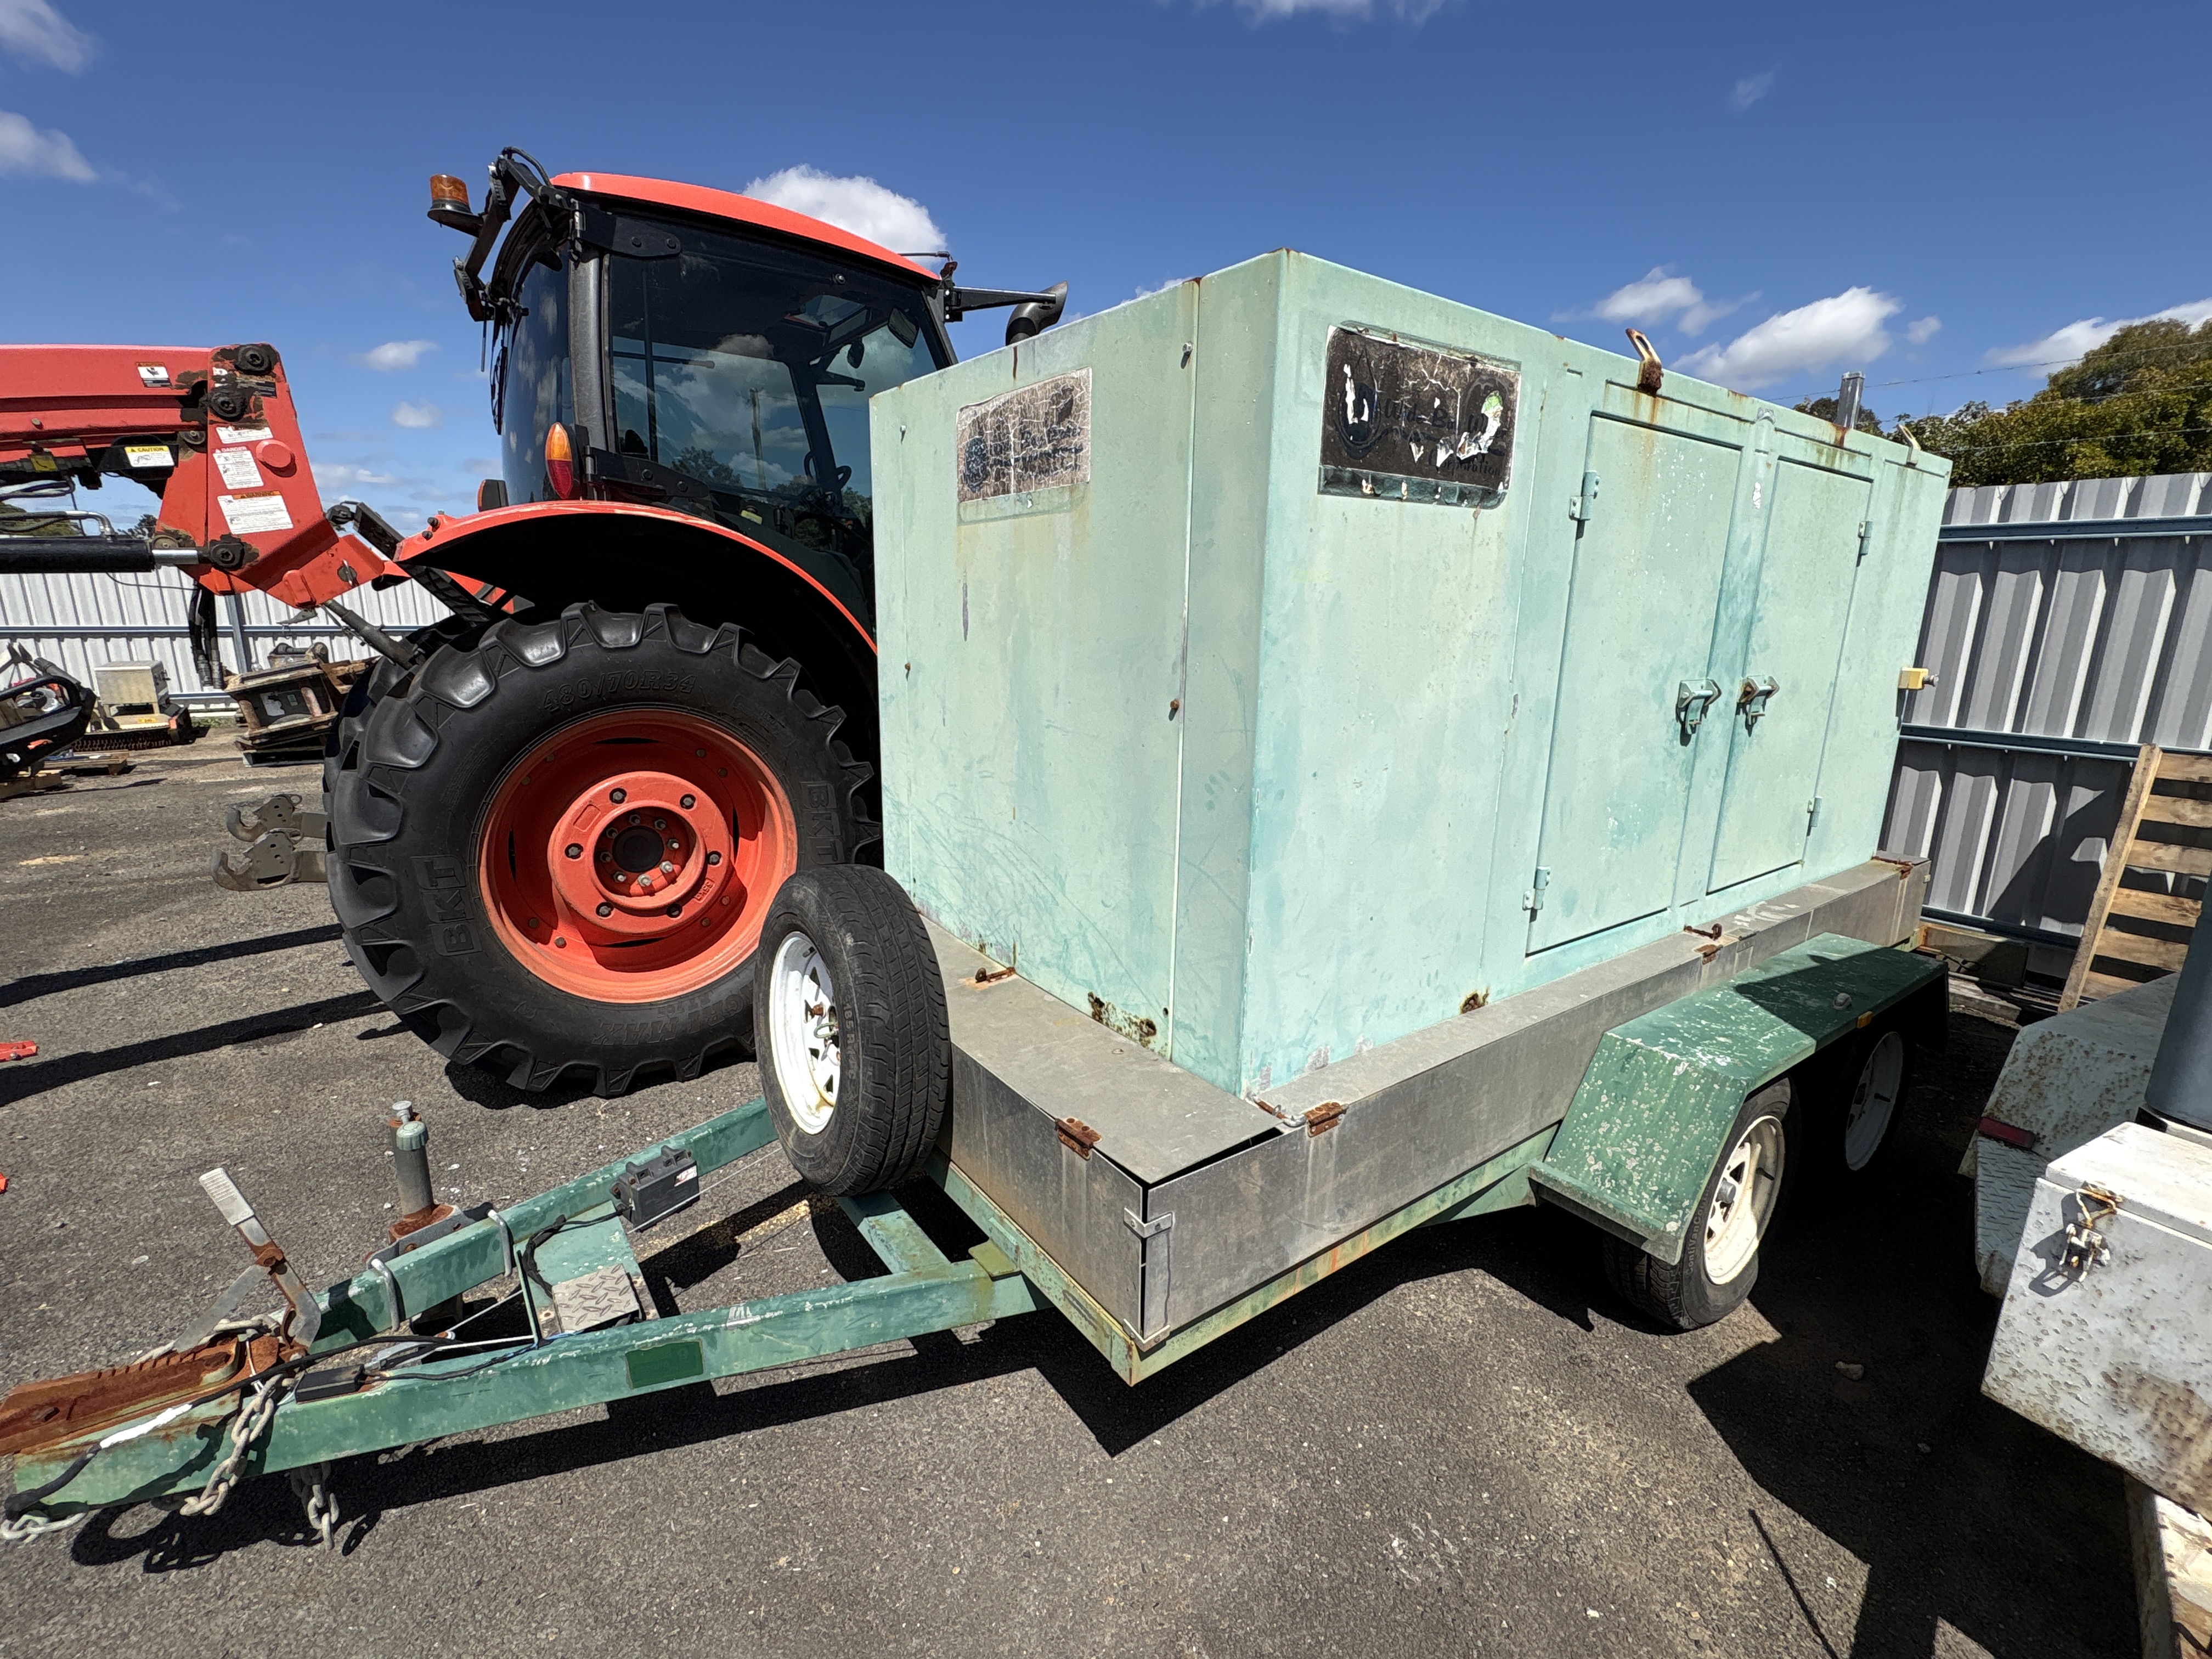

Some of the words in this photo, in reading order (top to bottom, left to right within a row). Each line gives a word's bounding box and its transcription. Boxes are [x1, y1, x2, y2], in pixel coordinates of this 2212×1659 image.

[246, 490, 275, 499] WARNING
[543, 669, 697, 713] 480/70R34
[807, 785, 838, 862] BKT
[424, 860, 475, 954] BKT
[843, 1003, 854, 1030] 185
